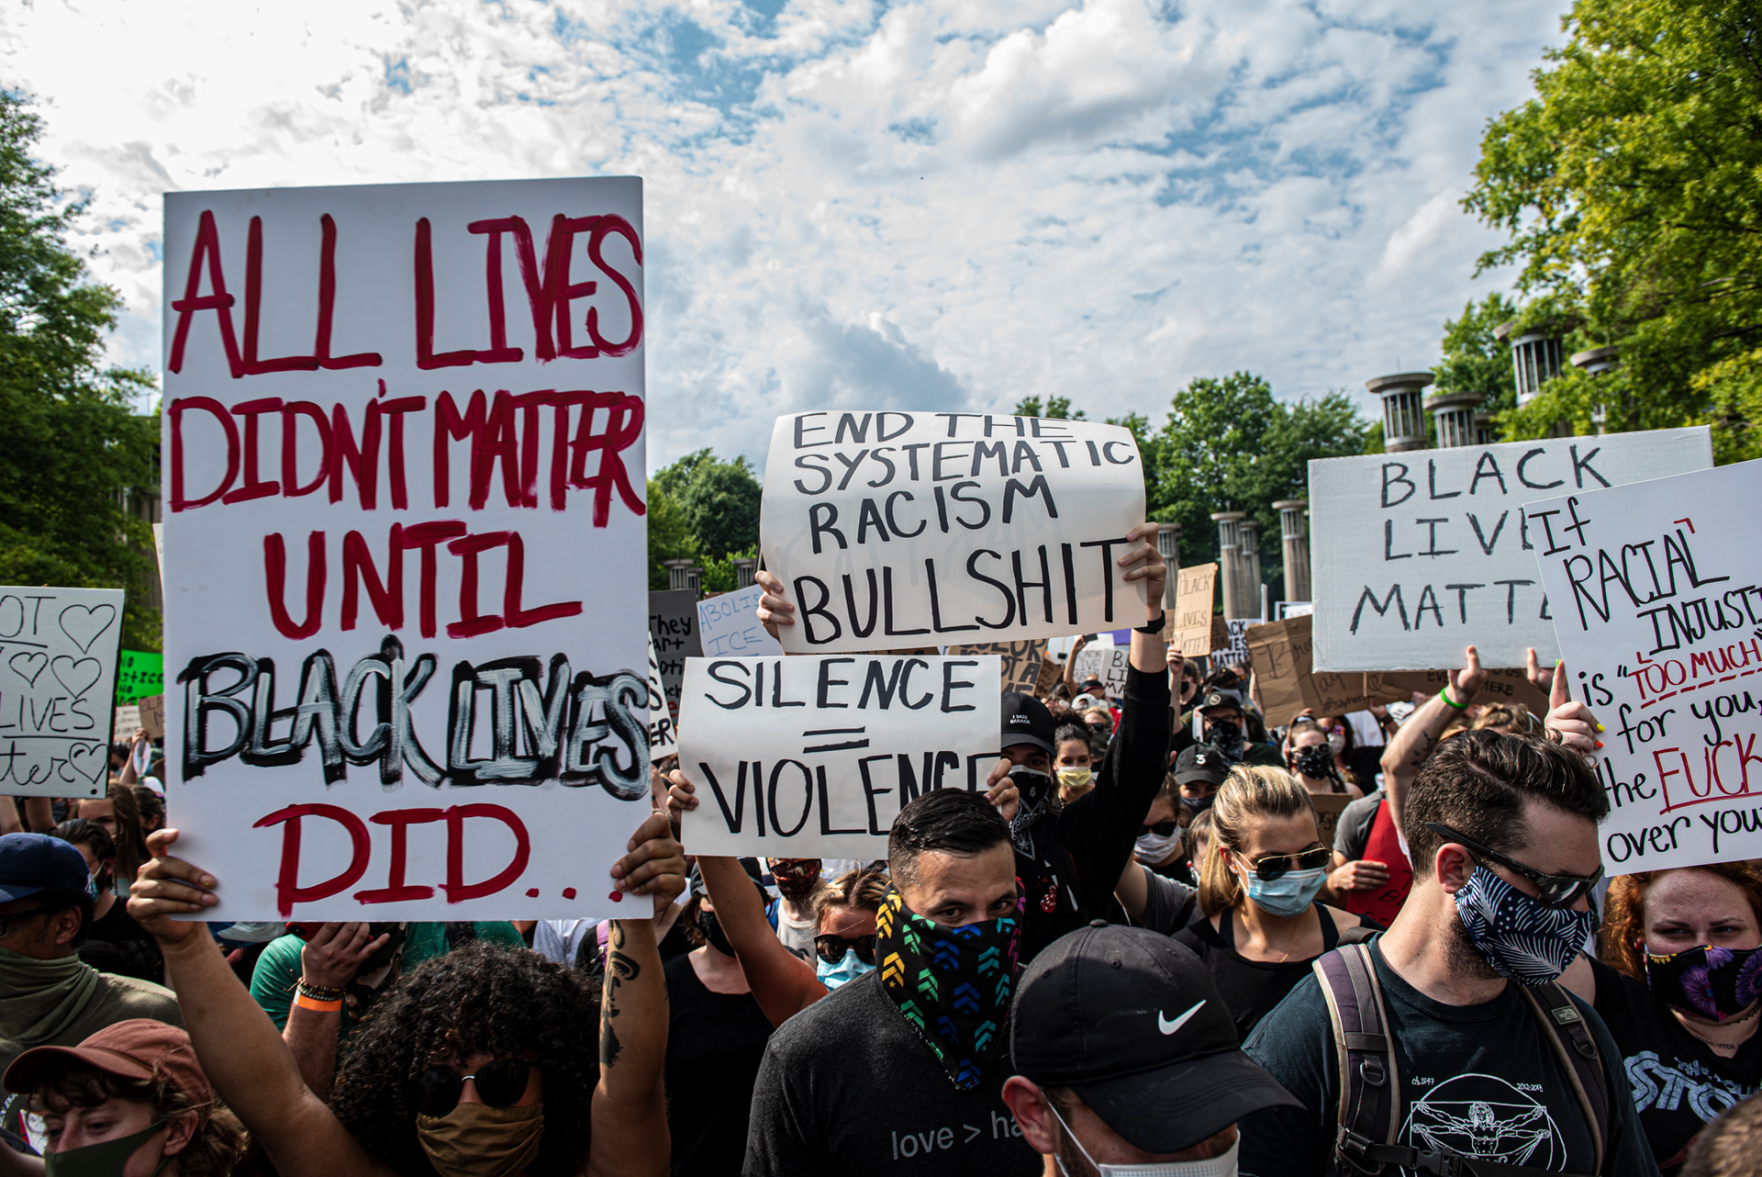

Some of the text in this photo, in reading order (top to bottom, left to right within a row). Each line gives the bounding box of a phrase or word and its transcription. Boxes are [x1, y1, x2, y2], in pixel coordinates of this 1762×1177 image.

[168, 210, 643, 378] ALL LIVES
[167, 378, 646, 527] DIDN'T MATTER
[794, 412, 1074, 449] END THE
[794, 440, 1135, 495] SYSTEMATIC
[1381, 444, 1612, 508] BLACK
[809, 474, 1059, 555] RACISM
[1528, 496, 1591, 556] If
[264, 521, 582, 639] UNTIL
[793, 537, 1132, 645] BULLSHIT
[1178, 572, 1213, 597] BLACK
[1563, 529, 1730, 631] RACIAL
[708, 626, 762, 656] ICE
[1174, 606, 1208, 629] LIVES
[705, 658, 979, 713] SILENCE
[1578, 671, 1614, 707] is
[178, 635, 652, 800] BLACK LIVES
[1617, 703, 1676, 755] for
[1196, 754, 1206, 765] 3
[1594, 757, 1657, 808] the
[1607, 816, 1691, 863] over
[891, 1126, 954, 1160] love
